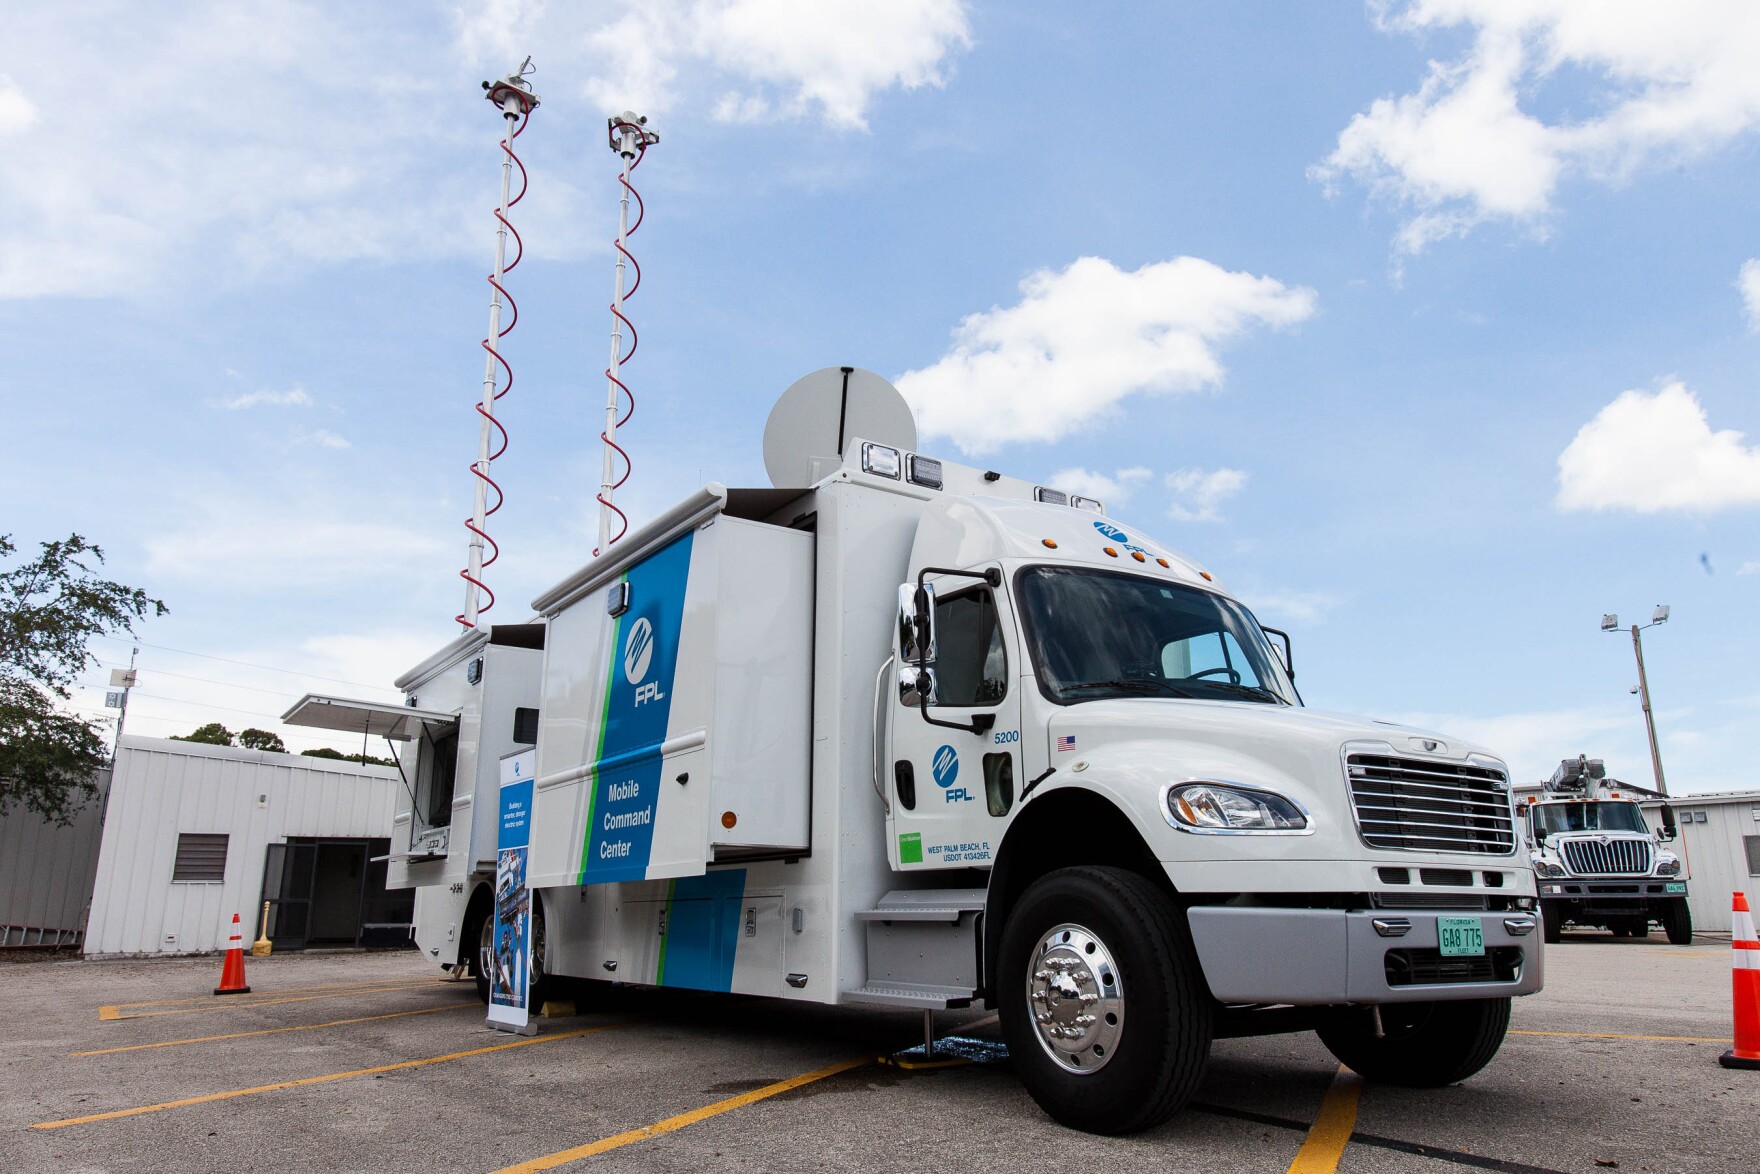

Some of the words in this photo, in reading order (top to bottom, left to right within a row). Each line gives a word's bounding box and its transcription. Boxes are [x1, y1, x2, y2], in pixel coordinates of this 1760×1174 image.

[634, 680, 664, 708] FPL
[994, 730, 1019, 744] 5200
[608, 779, 640, 803] Mobile
[945, 787, 973, 804] FPL
[603, 805, 651, 832] Command
[599, 840, 632, 860] Center
[928, 846, 942, 854] WEST
[944, 844, 958, 853] PALM
[960, 842, 981, 852] BEACH,
[982, 842, 990, 850] FL
[943, 853, 962, 862] USDOT
[1442, 928, 1461, 947] GA8
[1463, 928, 1482, 947] 775
